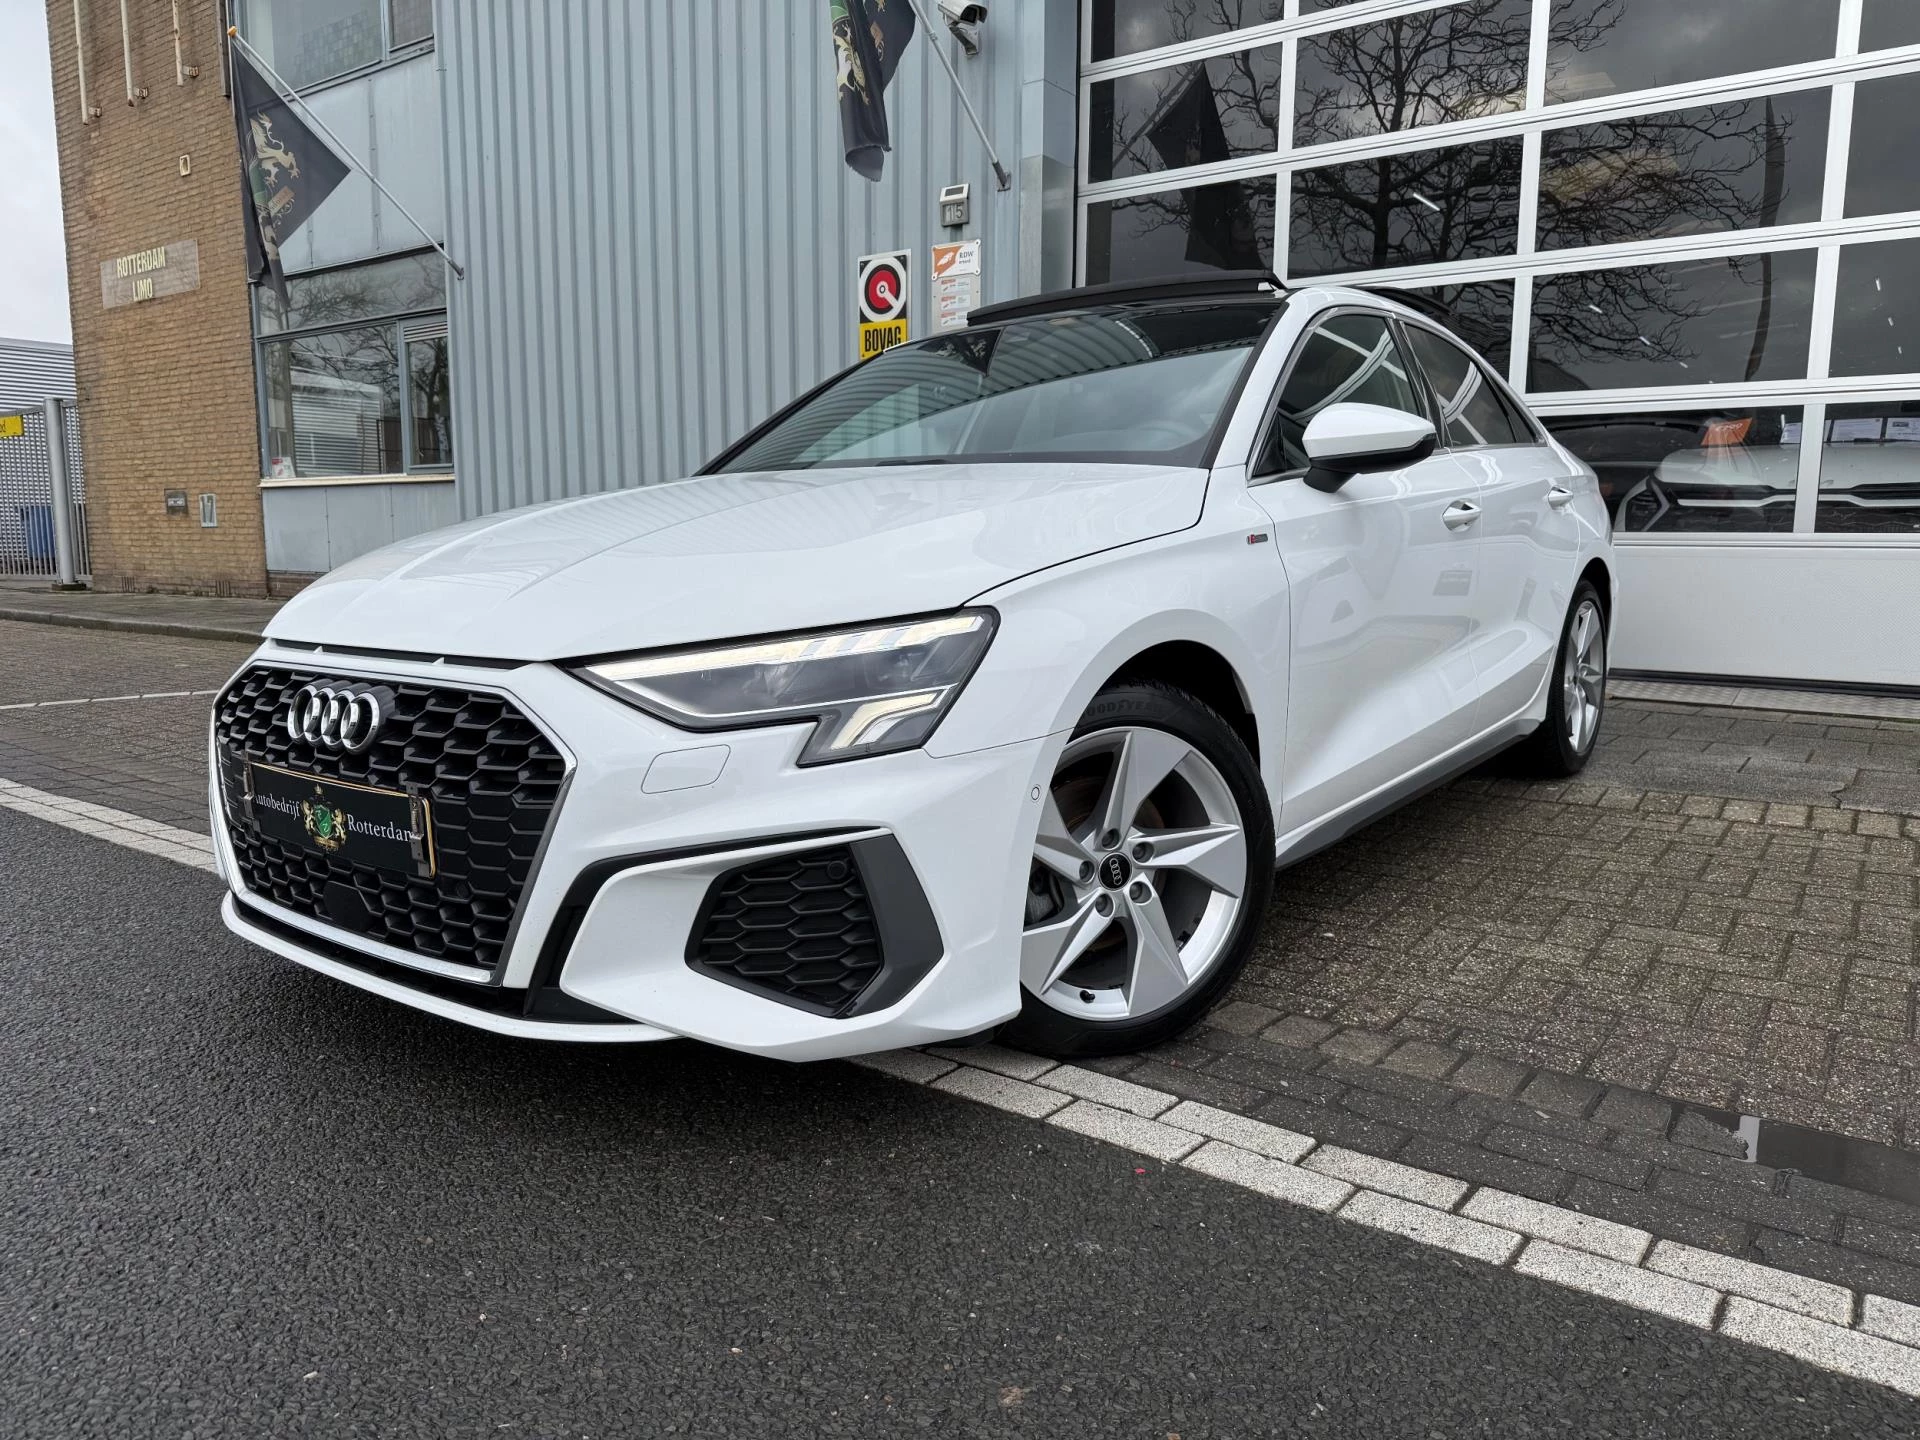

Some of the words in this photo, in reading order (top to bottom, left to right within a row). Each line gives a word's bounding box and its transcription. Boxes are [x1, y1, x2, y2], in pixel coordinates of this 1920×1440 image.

[116, 246, 166, 278] ROTTERDAM
[133, 278, 153, 302] LIMO
[864, 326, 902, 352] BOVAG
